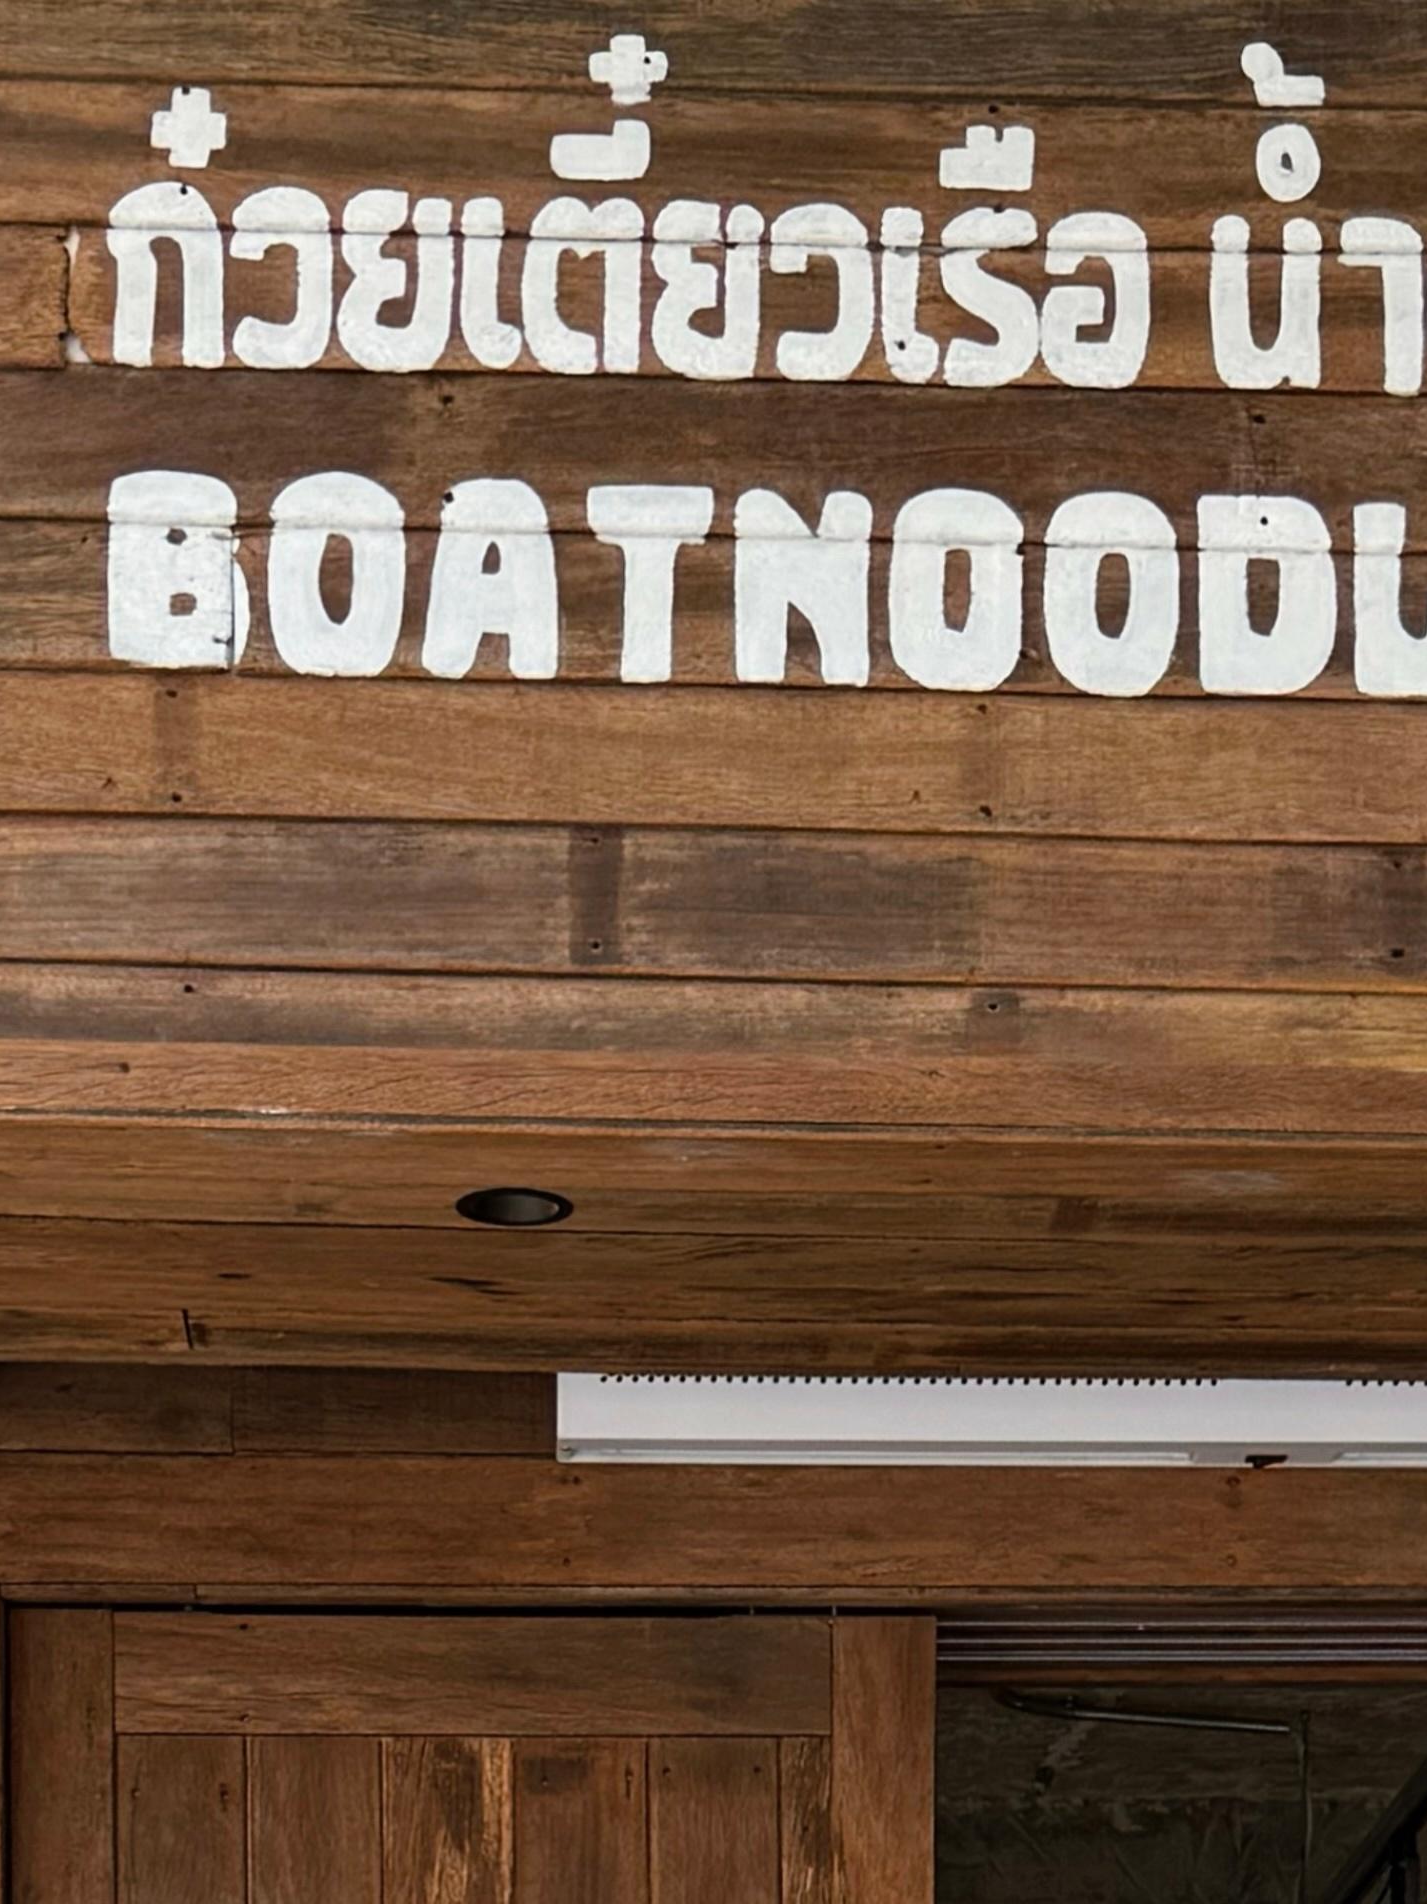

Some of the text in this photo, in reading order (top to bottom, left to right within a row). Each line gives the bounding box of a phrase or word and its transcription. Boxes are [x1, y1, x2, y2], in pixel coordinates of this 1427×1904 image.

[106, 33, 1152, 390] ก๋วยเตี๋ยวเรือ
